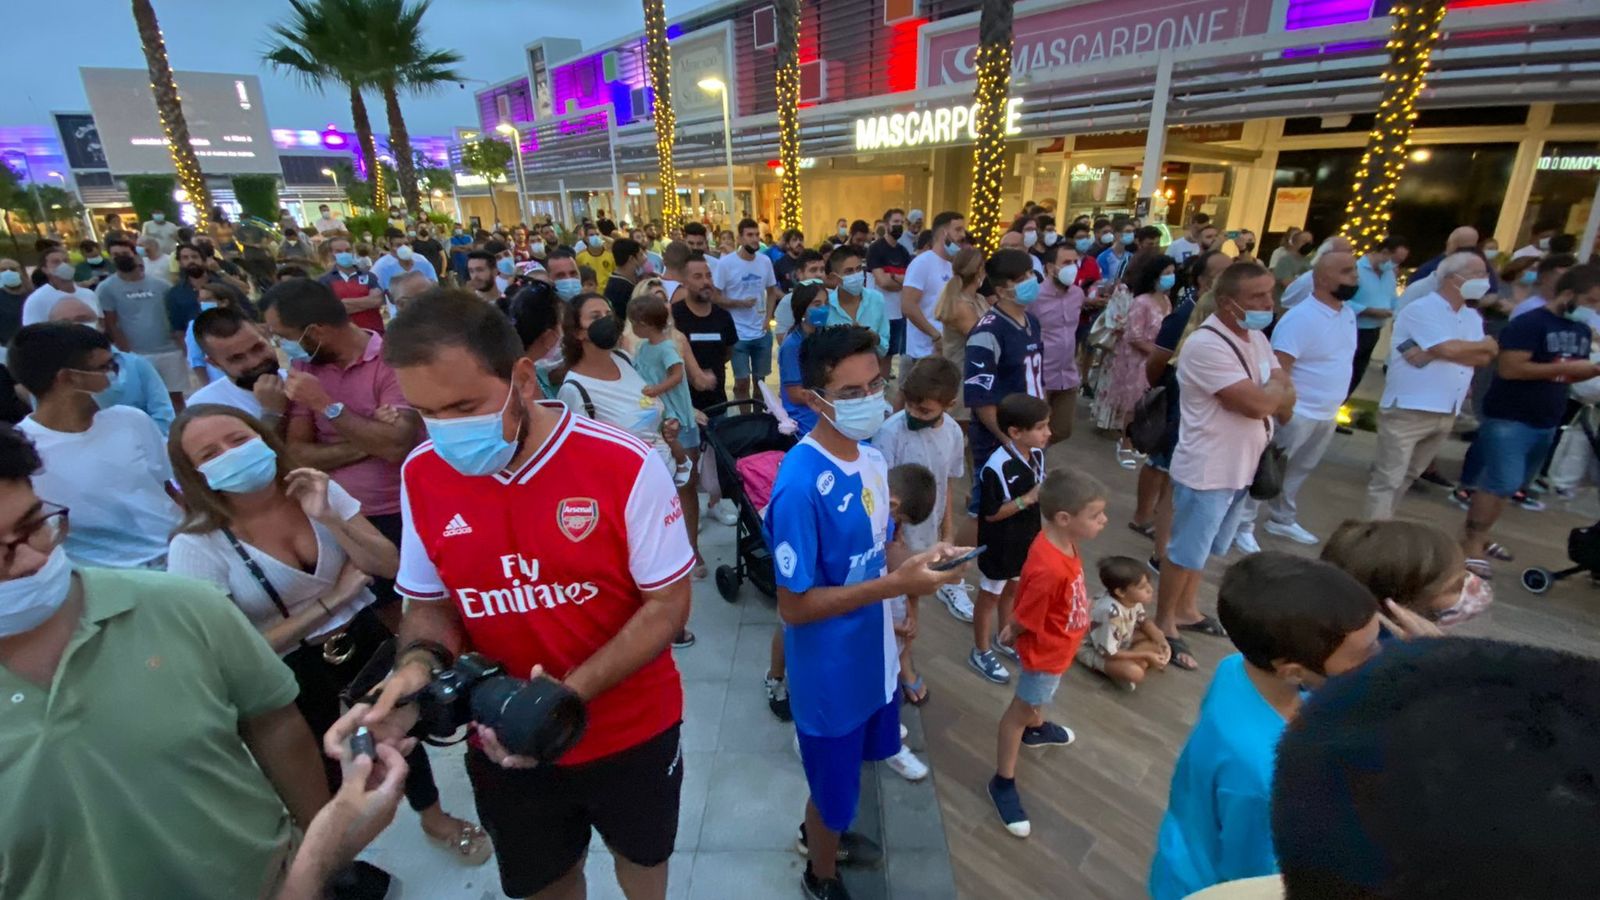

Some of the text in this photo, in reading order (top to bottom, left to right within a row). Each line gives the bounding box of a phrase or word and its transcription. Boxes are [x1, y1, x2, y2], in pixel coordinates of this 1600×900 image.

[855, 97, 1024, 150] MASCARPOE
[563, 504, 592, 514] Arsenal
[442, 526, 473, 537] adidas
[500, 552, 540, 582] Fly
[456, 578, 599, 618] Emirates
